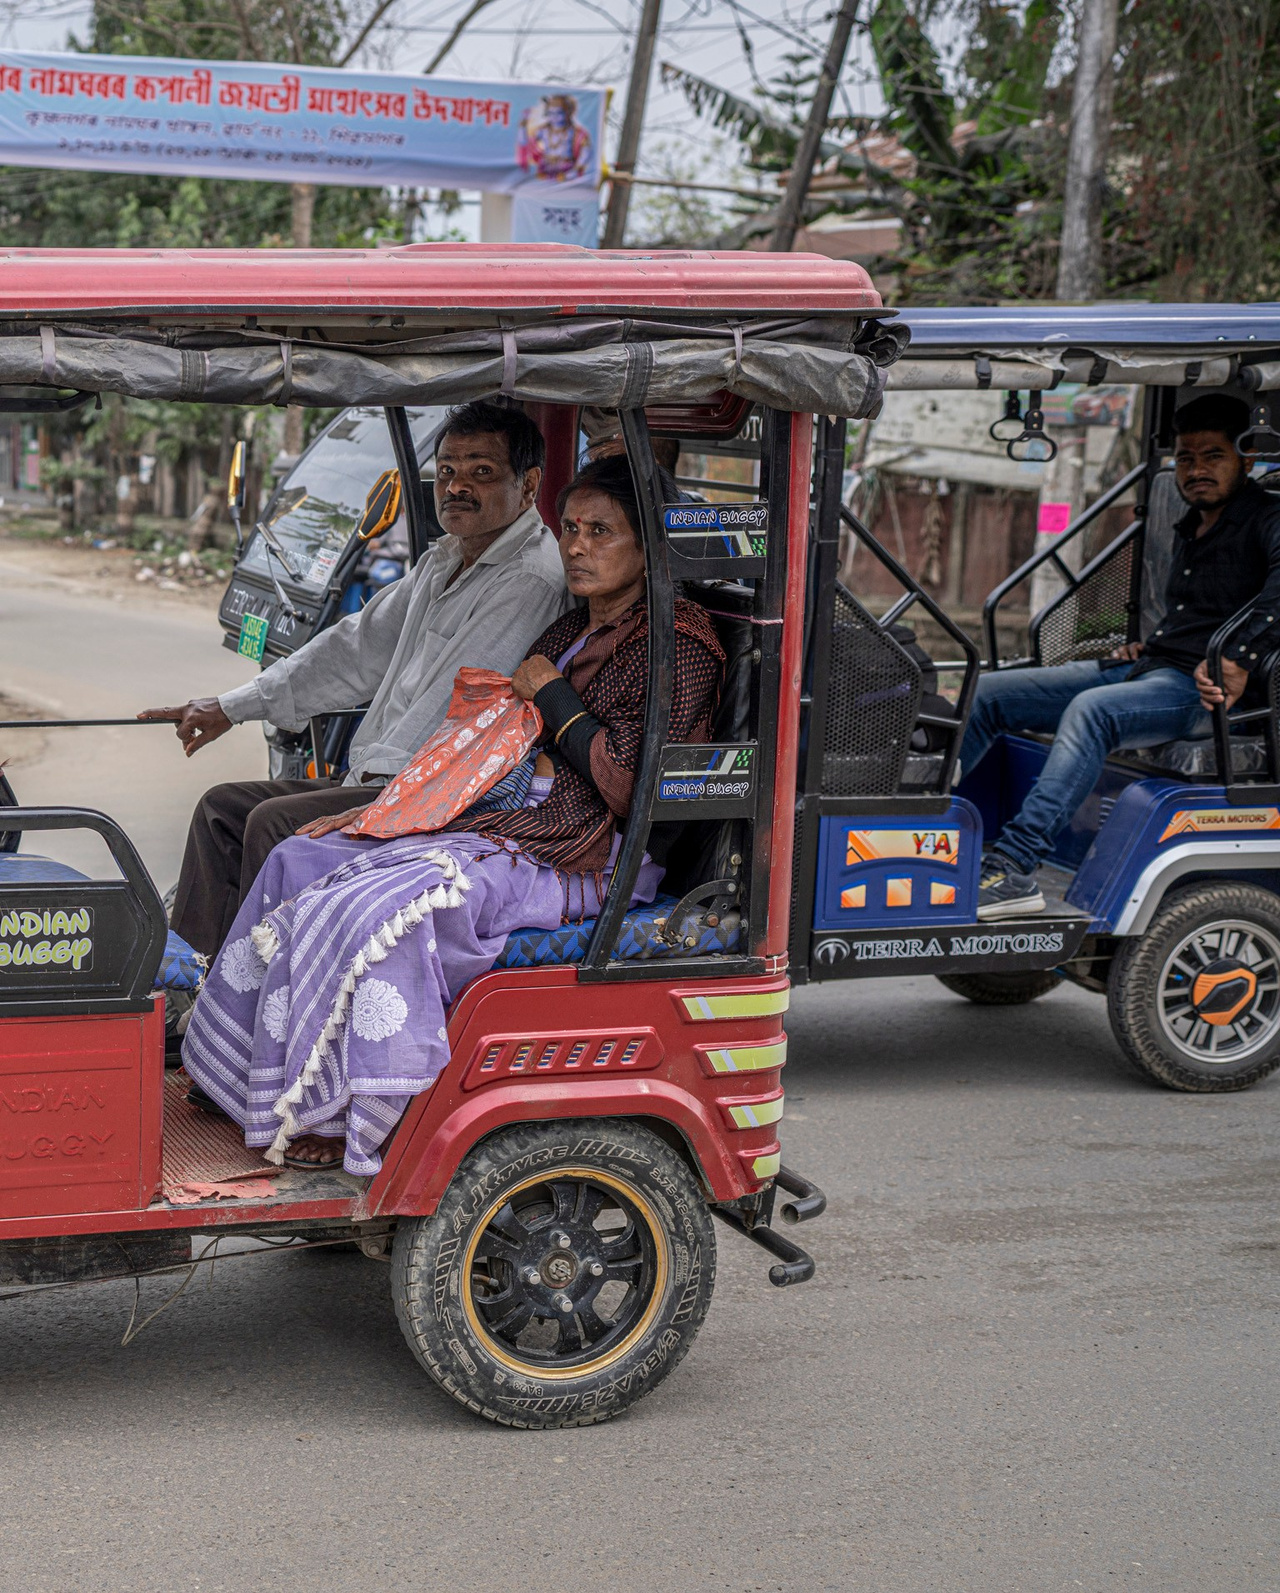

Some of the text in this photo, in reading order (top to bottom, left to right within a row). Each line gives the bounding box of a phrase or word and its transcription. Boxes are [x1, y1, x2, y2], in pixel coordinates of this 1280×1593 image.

[670, 509, 767, 527] INDIAN BUGGY
[663, 782, 749, 798] INDIAN BUGGY
[1196, 813, 1267, 824] TERRA MOTORS
[912, 833, 951, 855] Y4A
[853, 932, 1064, 960] TERRA MOTORS
[513, 1380, 544, 1396] BA23
